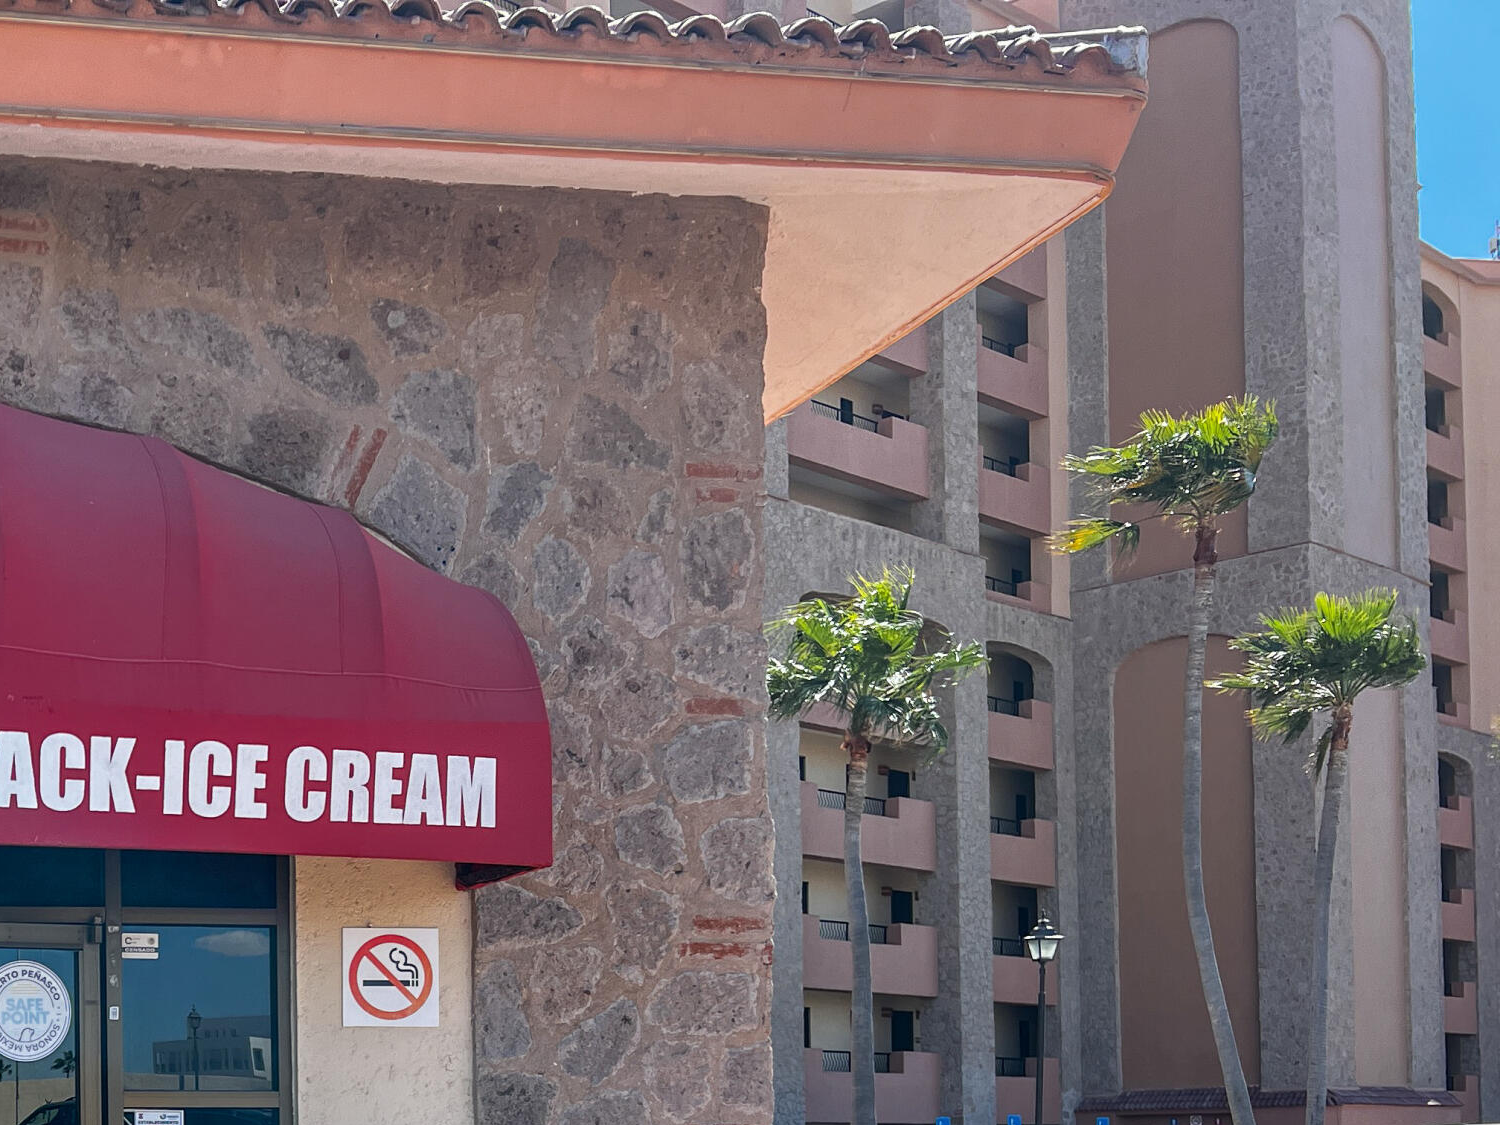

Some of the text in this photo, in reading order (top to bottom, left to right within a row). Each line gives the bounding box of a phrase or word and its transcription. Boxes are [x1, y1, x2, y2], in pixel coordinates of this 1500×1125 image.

[284, 746, 498, 829] CREAM
[22, 969, 60, 1000] PEÑASCO
[1, 1011, 50, 1025] POINT
[6, 998, 43, 1011] SAFE
[25, 1024, 60, 1052] SONORA
